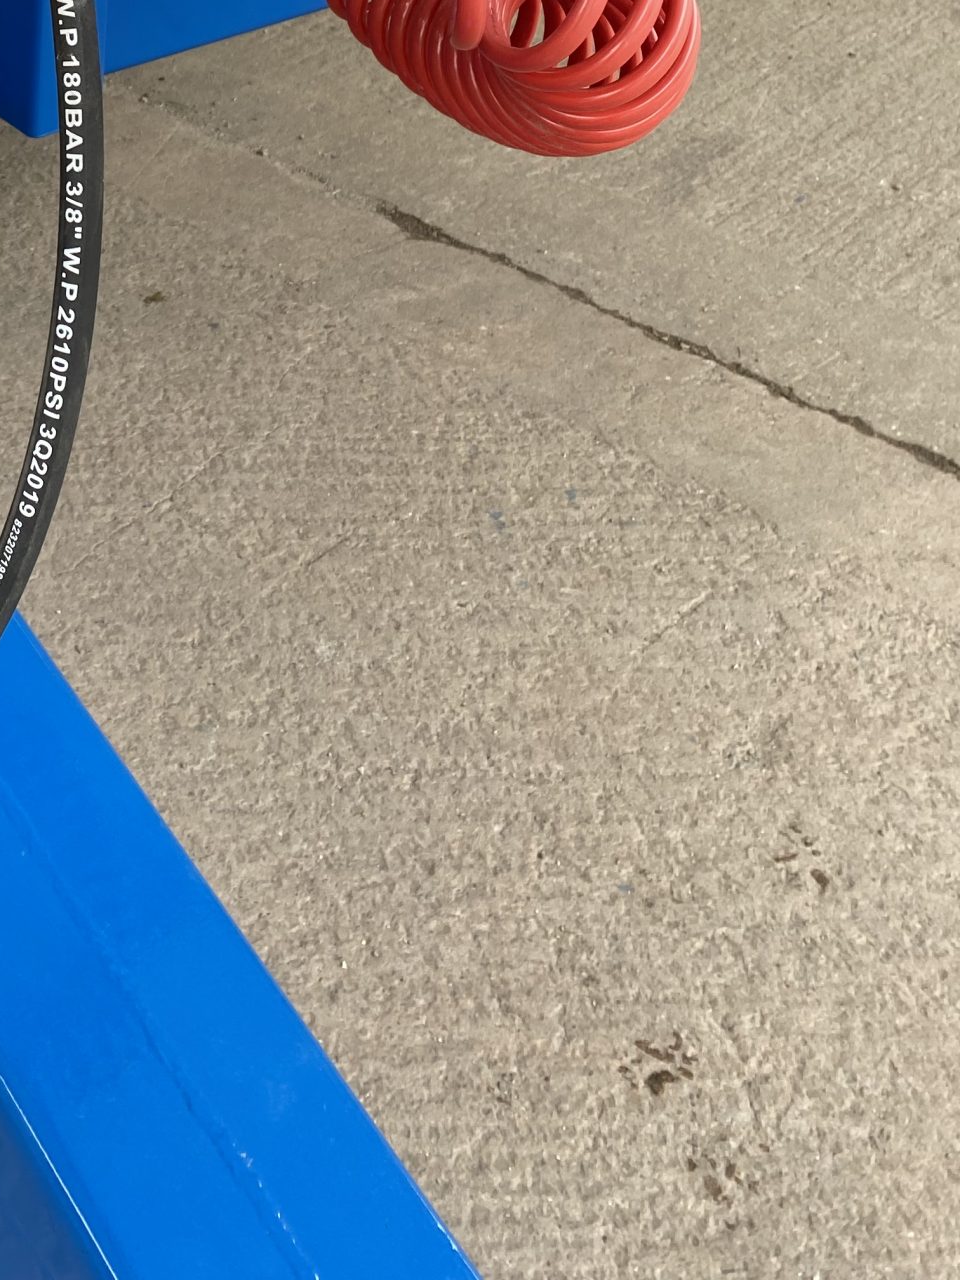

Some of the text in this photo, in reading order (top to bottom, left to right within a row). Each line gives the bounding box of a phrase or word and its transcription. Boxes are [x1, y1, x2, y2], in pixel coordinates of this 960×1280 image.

[62, 55, 84, 173] 180BAR
[64, 180, 84, 239] 3/8"
[61, 247, 82, 302] W.P
[43, 306, 76, 420] 2610PSI
[19, 423, 57, 518] 3Q2019
